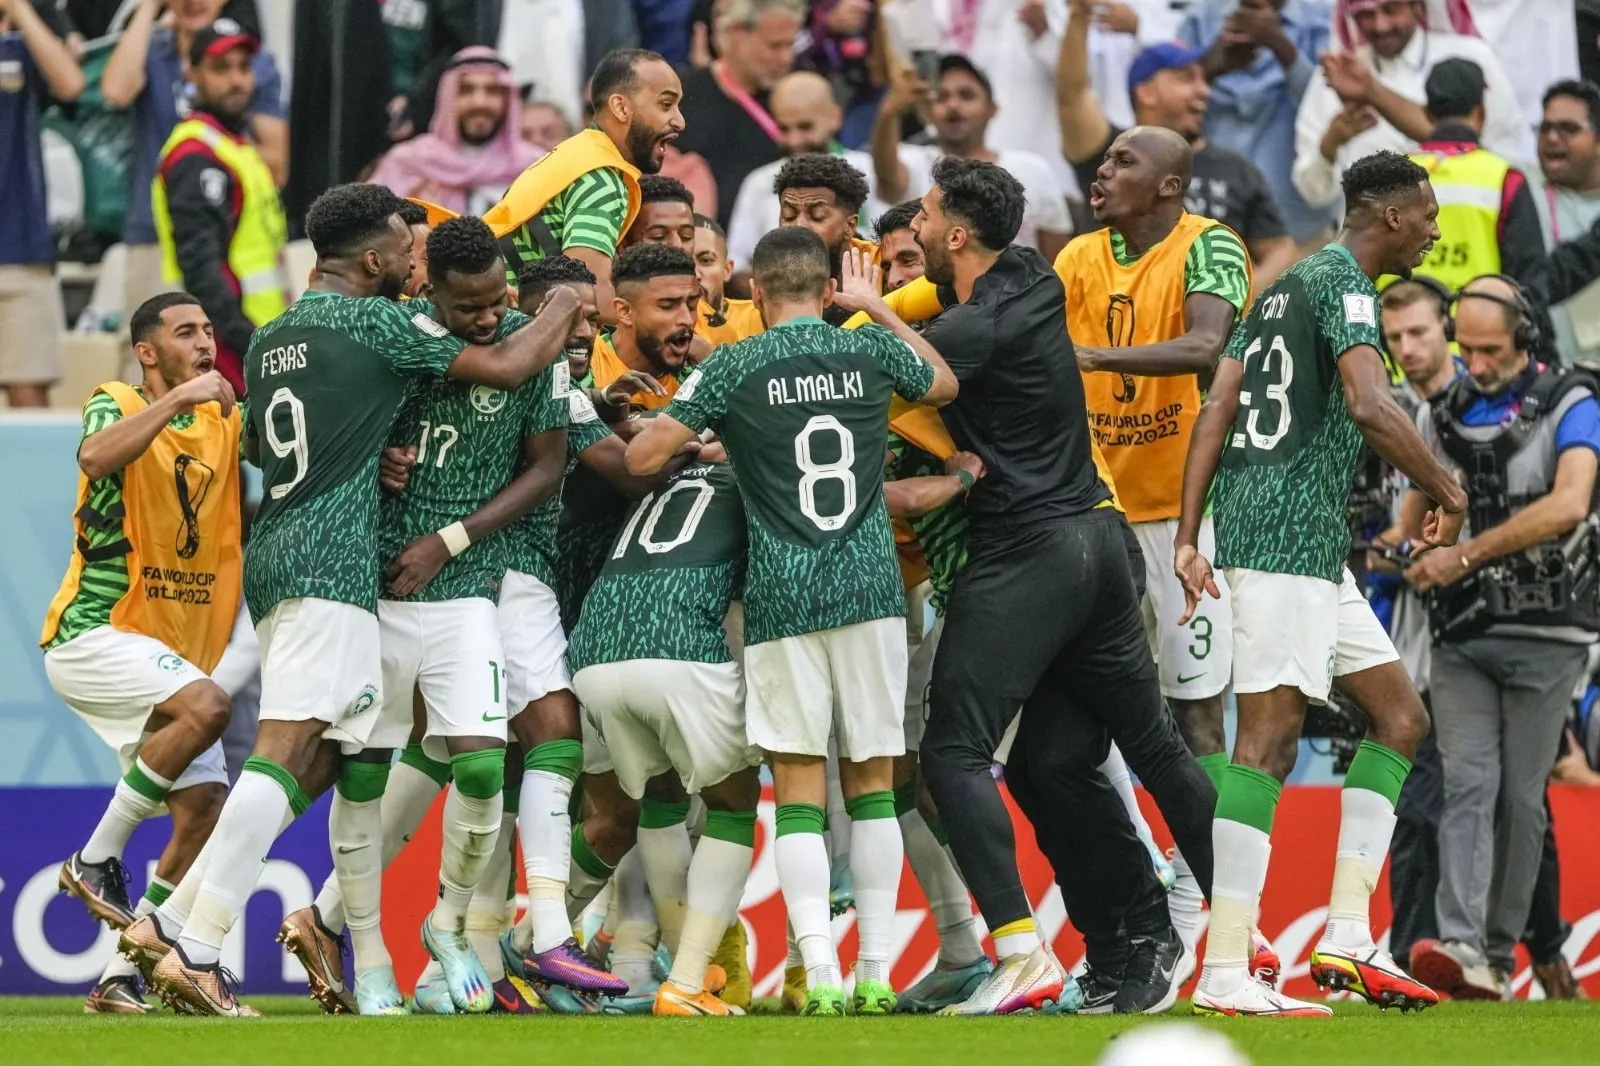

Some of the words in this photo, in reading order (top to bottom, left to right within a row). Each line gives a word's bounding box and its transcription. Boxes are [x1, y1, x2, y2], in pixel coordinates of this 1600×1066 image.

[261, 343, 307, 379] FERAS
[767, 371, 864, 406] ALMALKI
[1113, 413, 1152, 428] ORLD
[1155, 403, 1183, 422] CUP
[265, 387, 309, 500] 9
[417, 420, 459, 468] 17
[795, 414, 857, 532] 8
[612, 478, 715, 560] 10
[1189, 616, 1212, 660] 3
[0, 858, 316, 984] om
